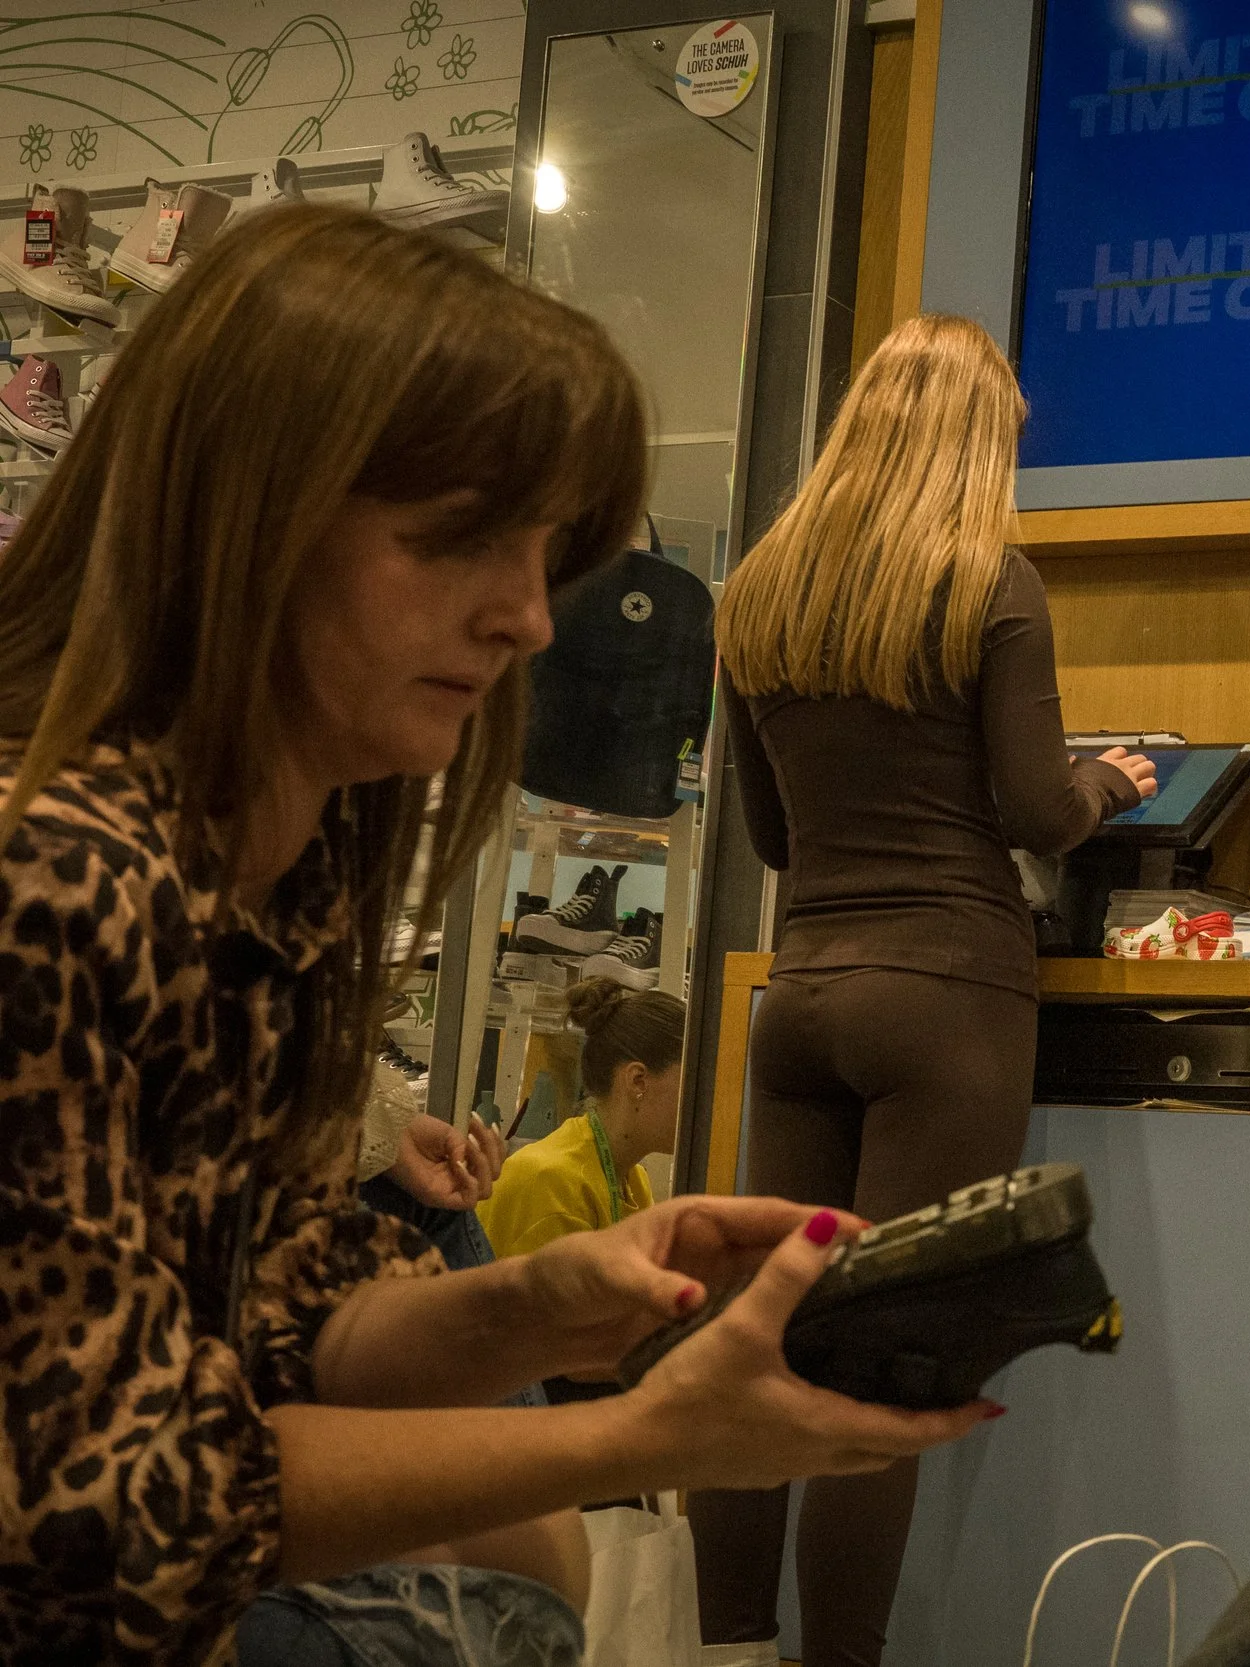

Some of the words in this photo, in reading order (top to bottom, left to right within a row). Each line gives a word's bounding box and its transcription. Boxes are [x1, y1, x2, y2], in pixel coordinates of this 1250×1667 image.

[687, 58, 713, 75] LOVES
[715, 53, 749, 71] SCHUH
[692, 43, 708, 58] THE
[710, 38, 745, 56] CAMERA
[1068, 82, 1226, 138] TIME
[1056, 277, 1213, 332] TIME
